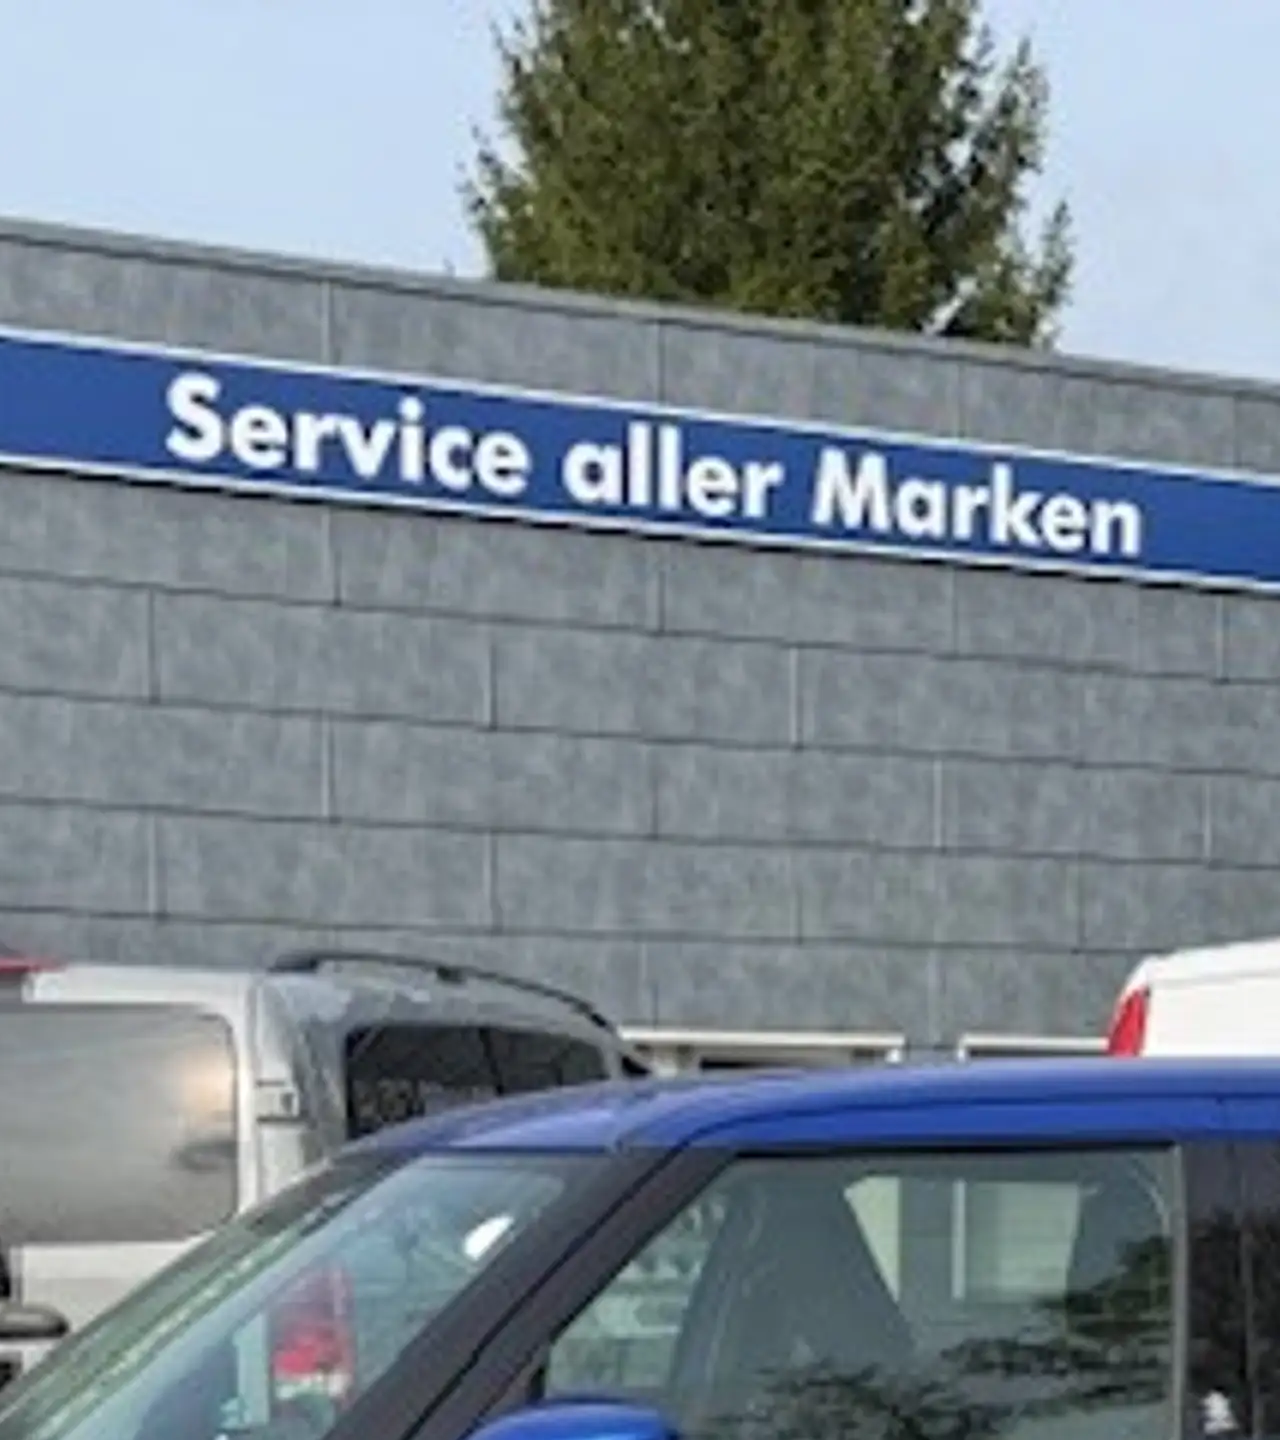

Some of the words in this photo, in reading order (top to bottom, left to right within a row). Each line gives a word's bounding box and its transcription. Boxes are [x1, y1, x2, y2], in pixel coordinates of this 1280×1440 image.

[165, 372, 531, 496] Service
[562, 421, 785, 518] aller
[812, 447, 1141, 556] Marken
